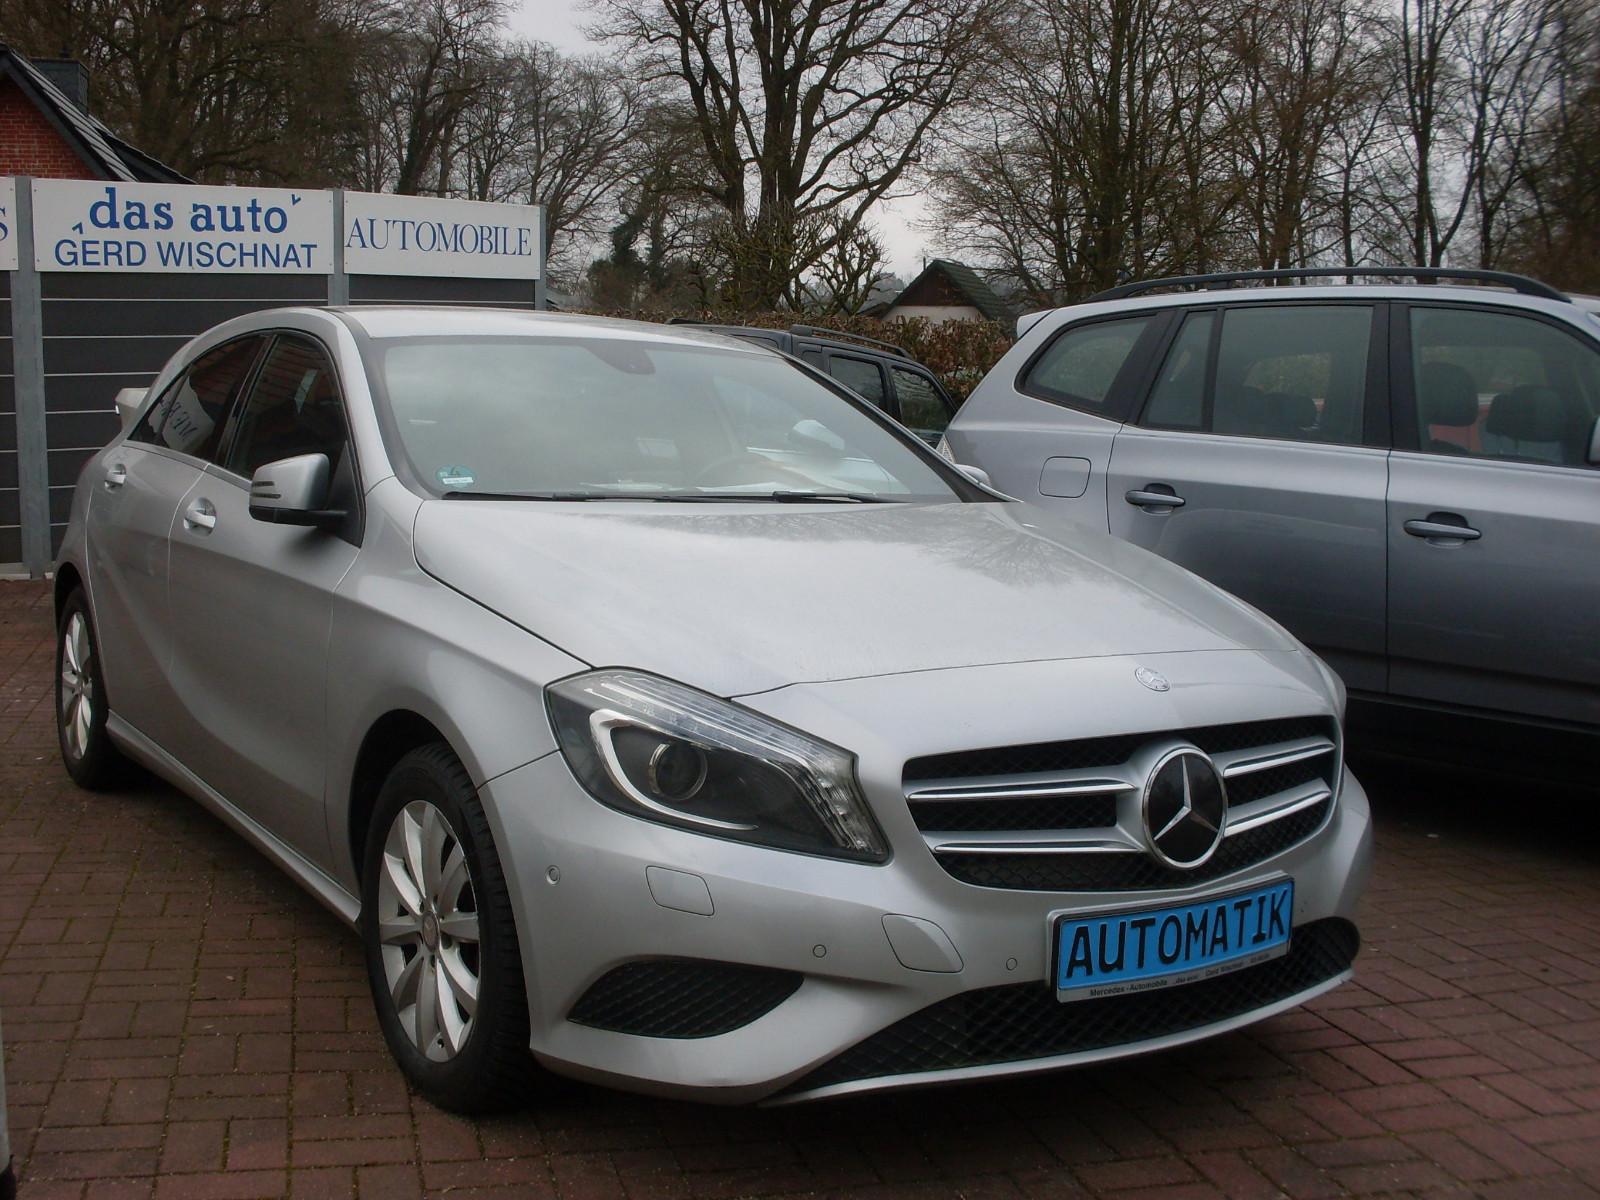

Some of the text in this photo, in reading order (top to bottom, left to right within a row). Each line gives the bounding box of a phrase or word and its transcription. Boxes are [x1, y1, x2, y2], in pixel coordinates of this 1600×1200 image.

[89, 186, 175, 231] das
[54, 238, 318, 268] GERD WISCHNAT
[344, 216, 532, 256] AUTOMOBILE
[1065, 888, 1288, 979] AUTOMATIK
